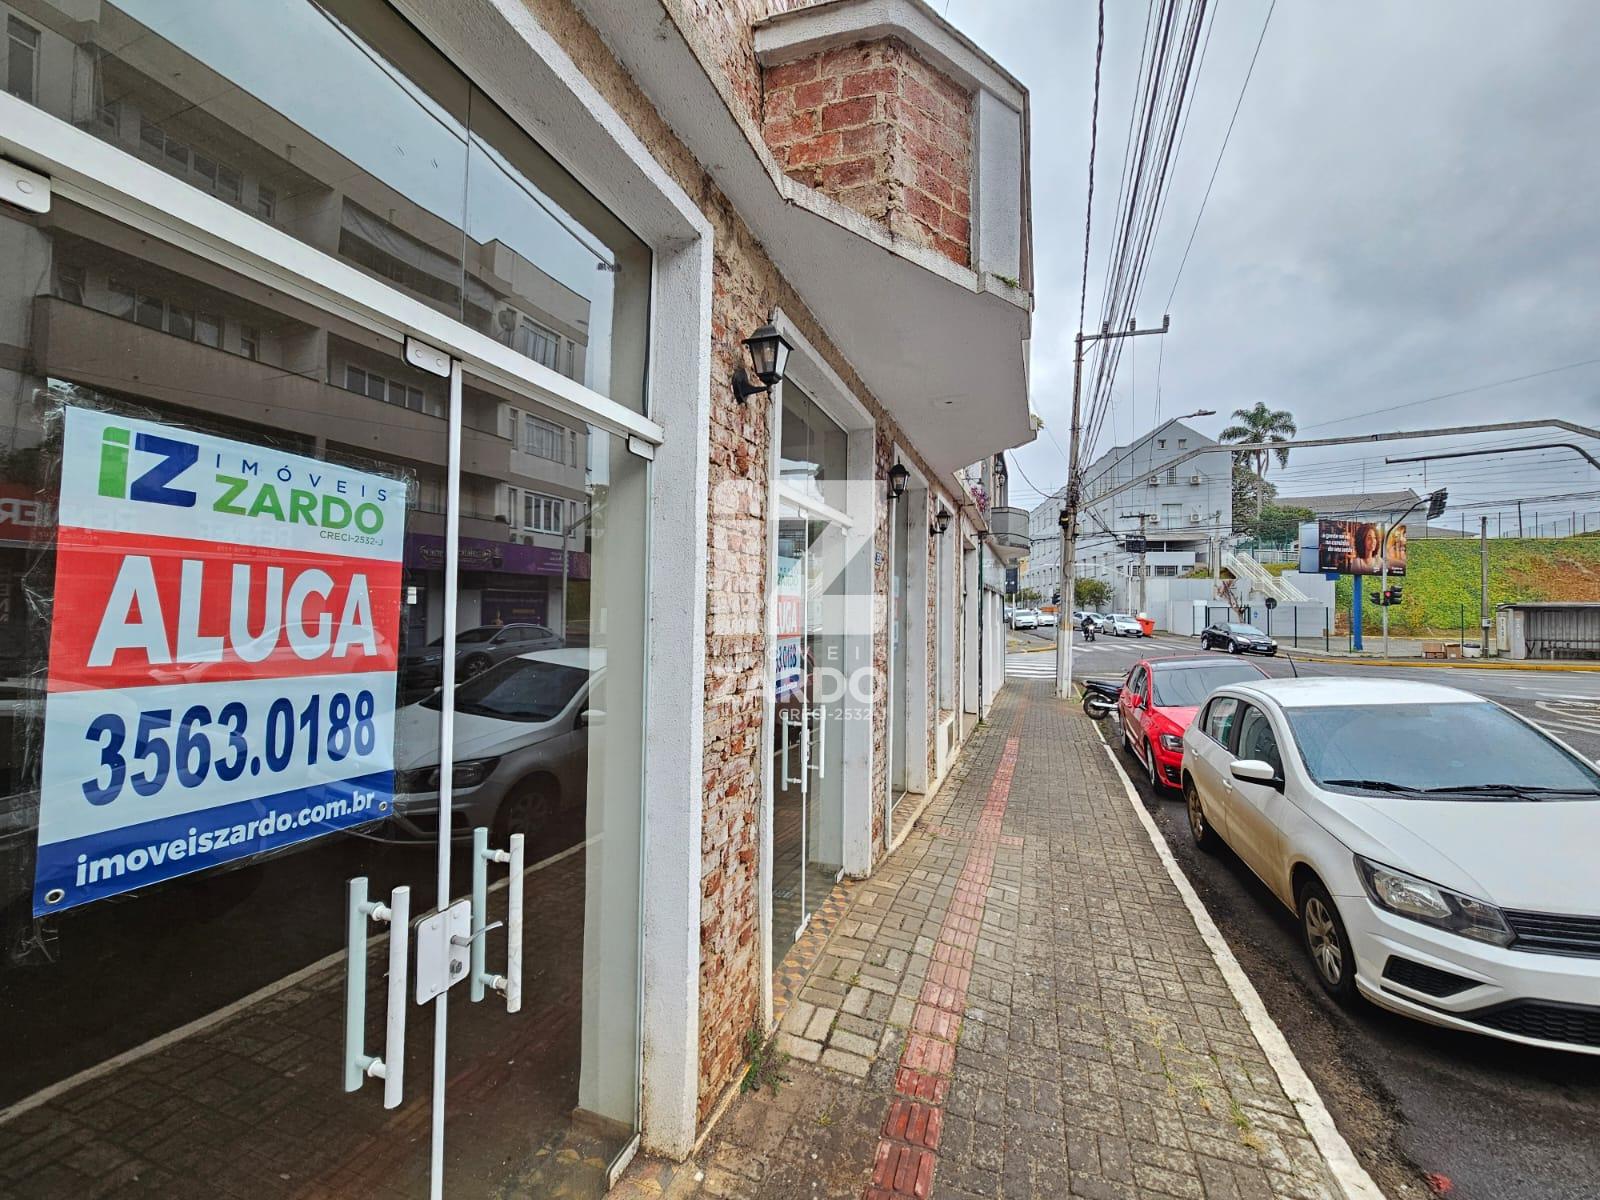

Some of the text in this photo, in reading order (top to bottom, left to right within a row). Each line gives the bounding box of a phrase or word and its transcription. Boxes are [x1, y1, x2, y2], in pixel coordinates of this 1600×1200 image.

[212, 473, 384, 534] ZARDO
[216, 453, 387, 501] IMÓVEIS
[319, 530, 383, 547] CRECI-2532-J
[87, 555, 377, 667] ALUGA
[82, 690, 375, 806] 3563.0188
[75, 791, 375, 887] imoveiszardo.com.br
